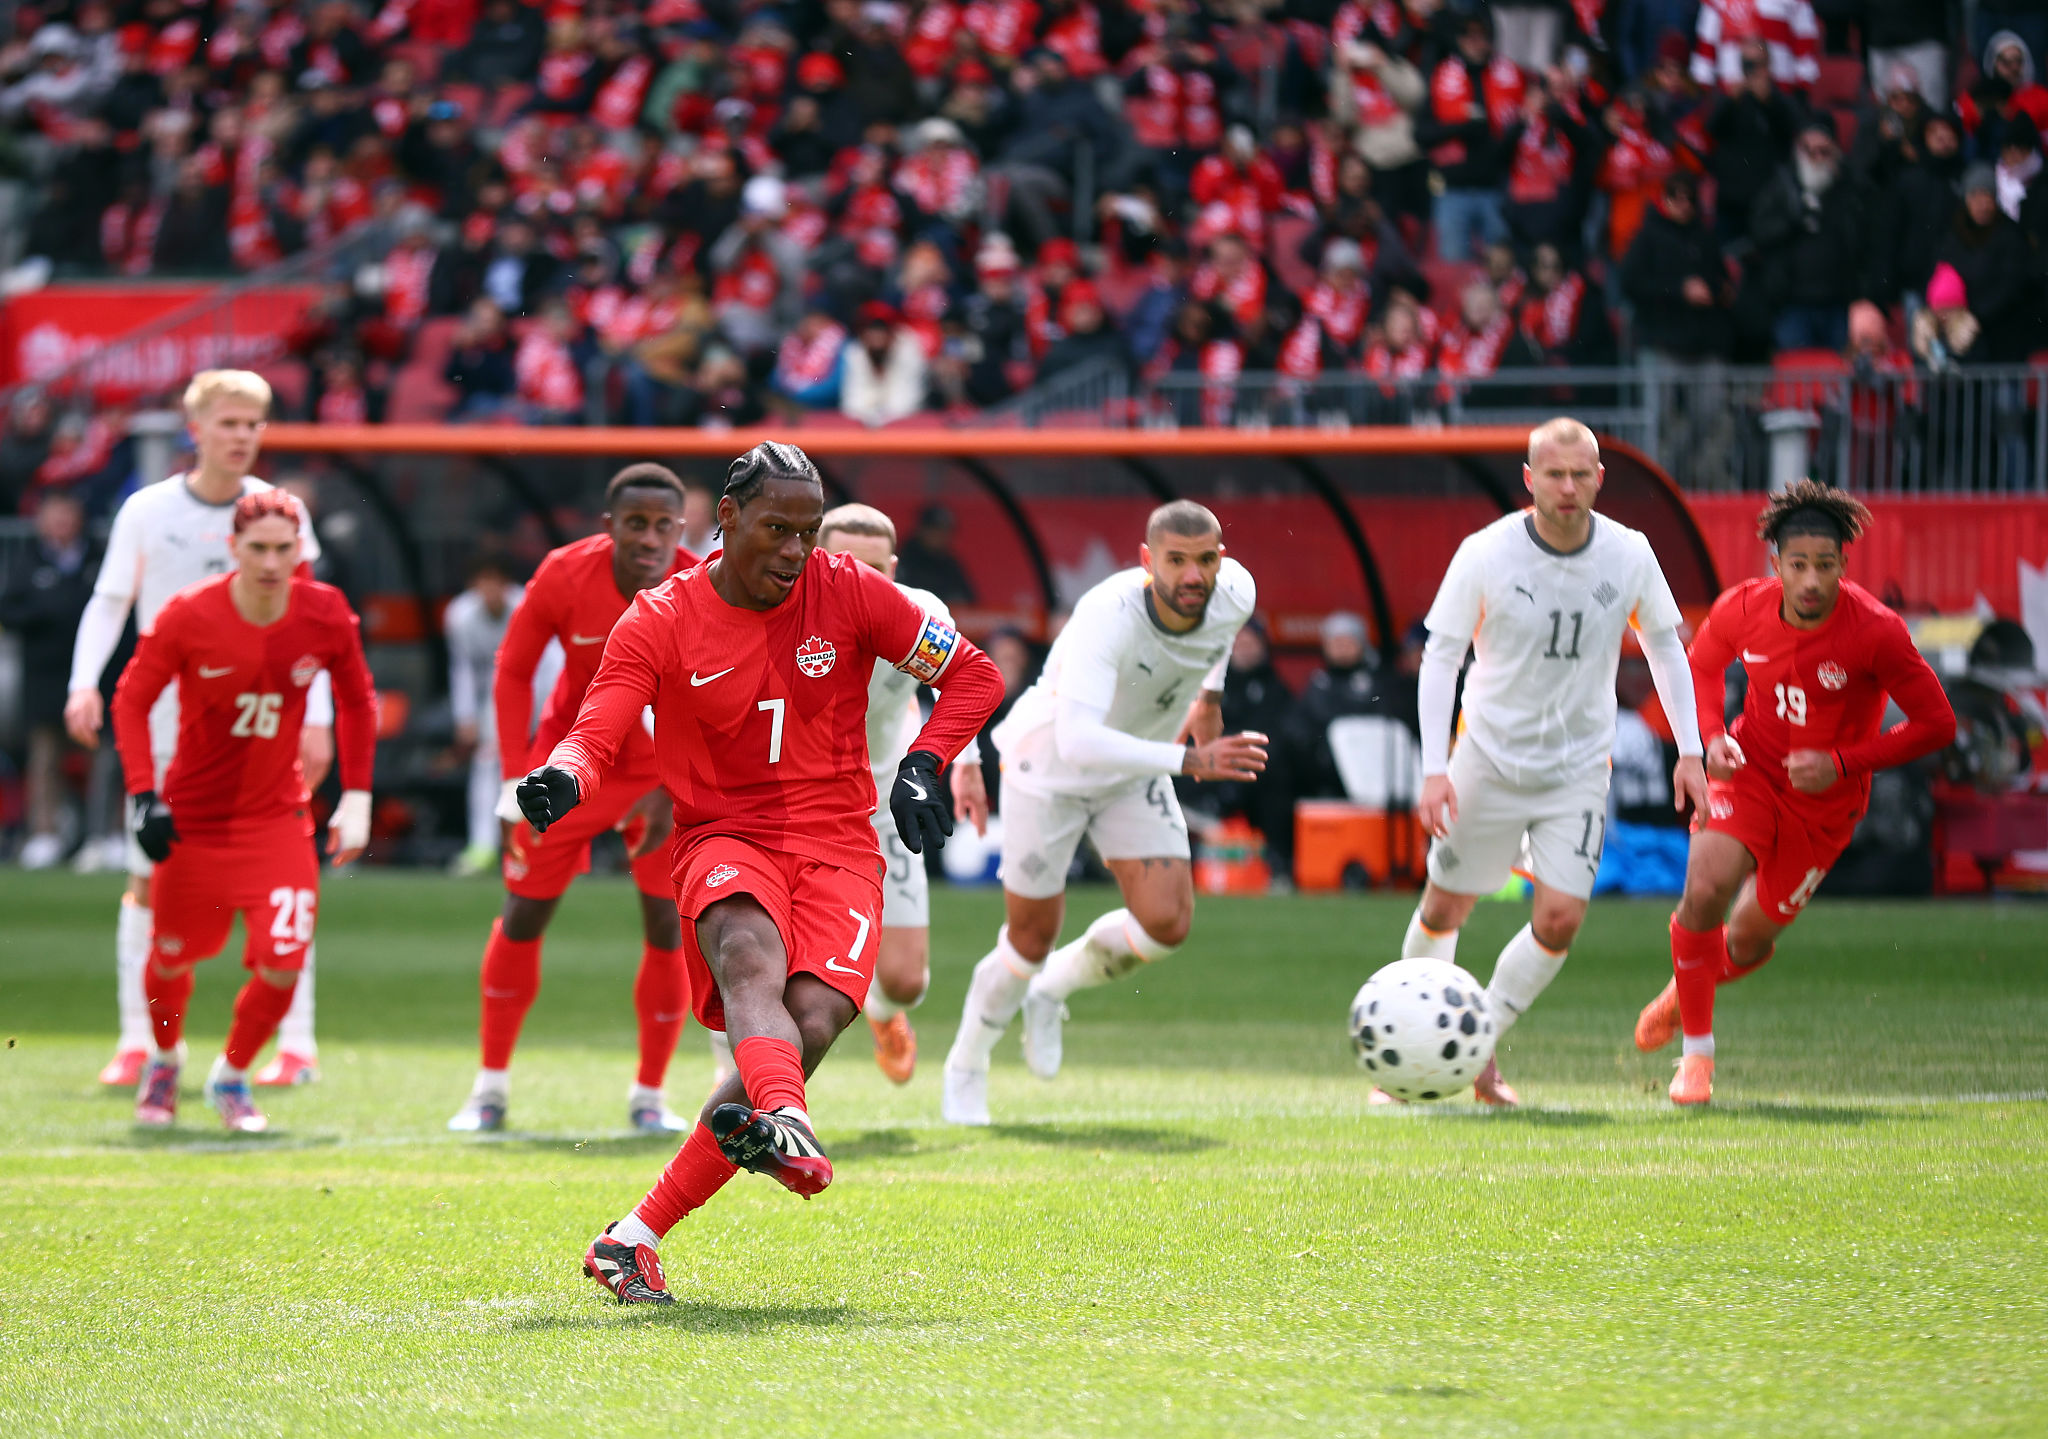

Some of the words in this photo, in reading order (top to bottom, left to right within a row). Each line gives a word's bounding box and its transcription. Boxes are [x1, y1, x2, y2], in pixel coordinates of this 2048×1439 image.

[797, 651, 835, 664] CANADA
[1543, 609, 1583, 659] 11
[230, 692, 284, 739] 26
[1156, 677, 1183, 711] 4
[1774, 681, 1807, 727] 19
[757, 698, 785, 763] 7
[1145, 777, 1172, 818] 4
[269, 886, 316, 942] 26
[848, 907, 870, 961] 7
